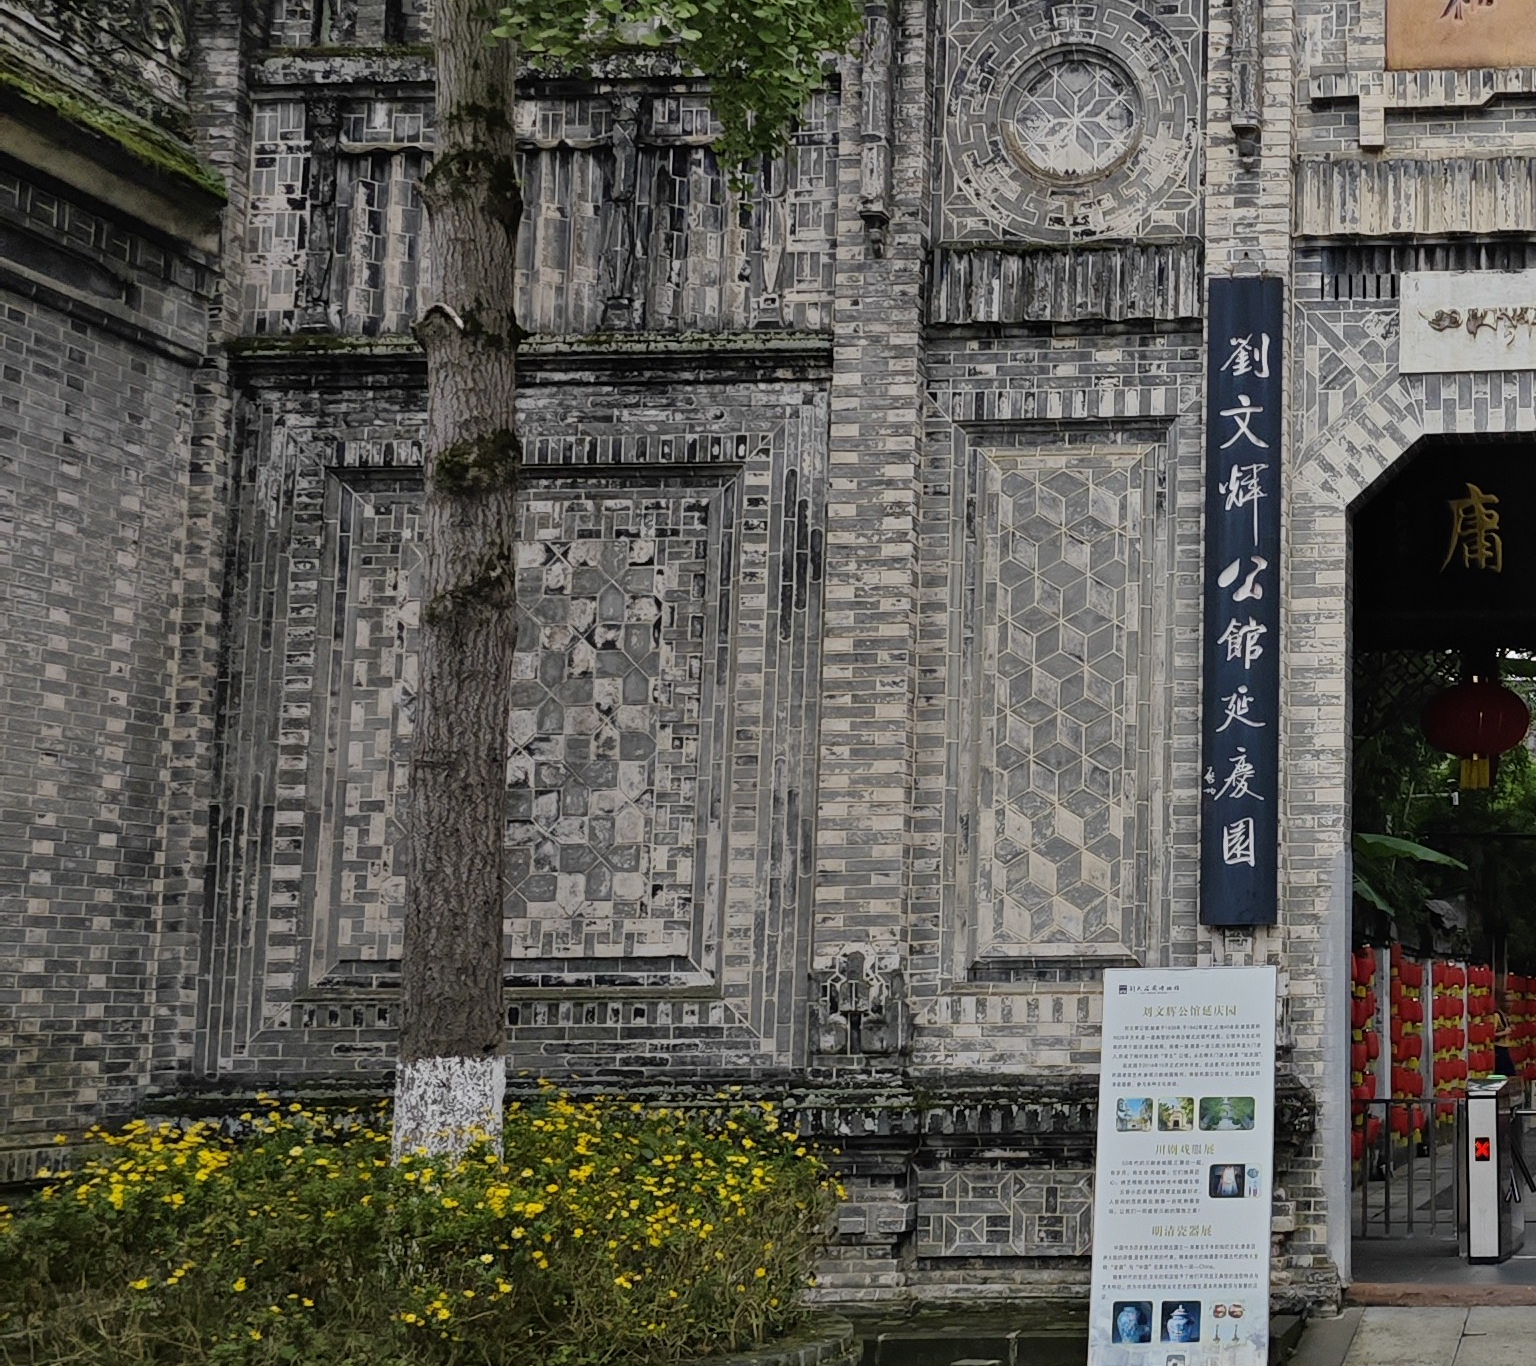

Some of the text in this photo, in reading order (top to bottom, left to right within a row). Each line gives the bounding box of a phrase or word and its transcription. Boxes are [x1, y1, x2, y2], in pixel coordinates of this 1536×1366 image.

[1142, 1005, 1237, 1017] 刘文辉公馆延庆园
[1155, 1143, 1215, 1155] 川剧戏服展
[1151, 1225, 1212, 1237] 明清瓷器展
